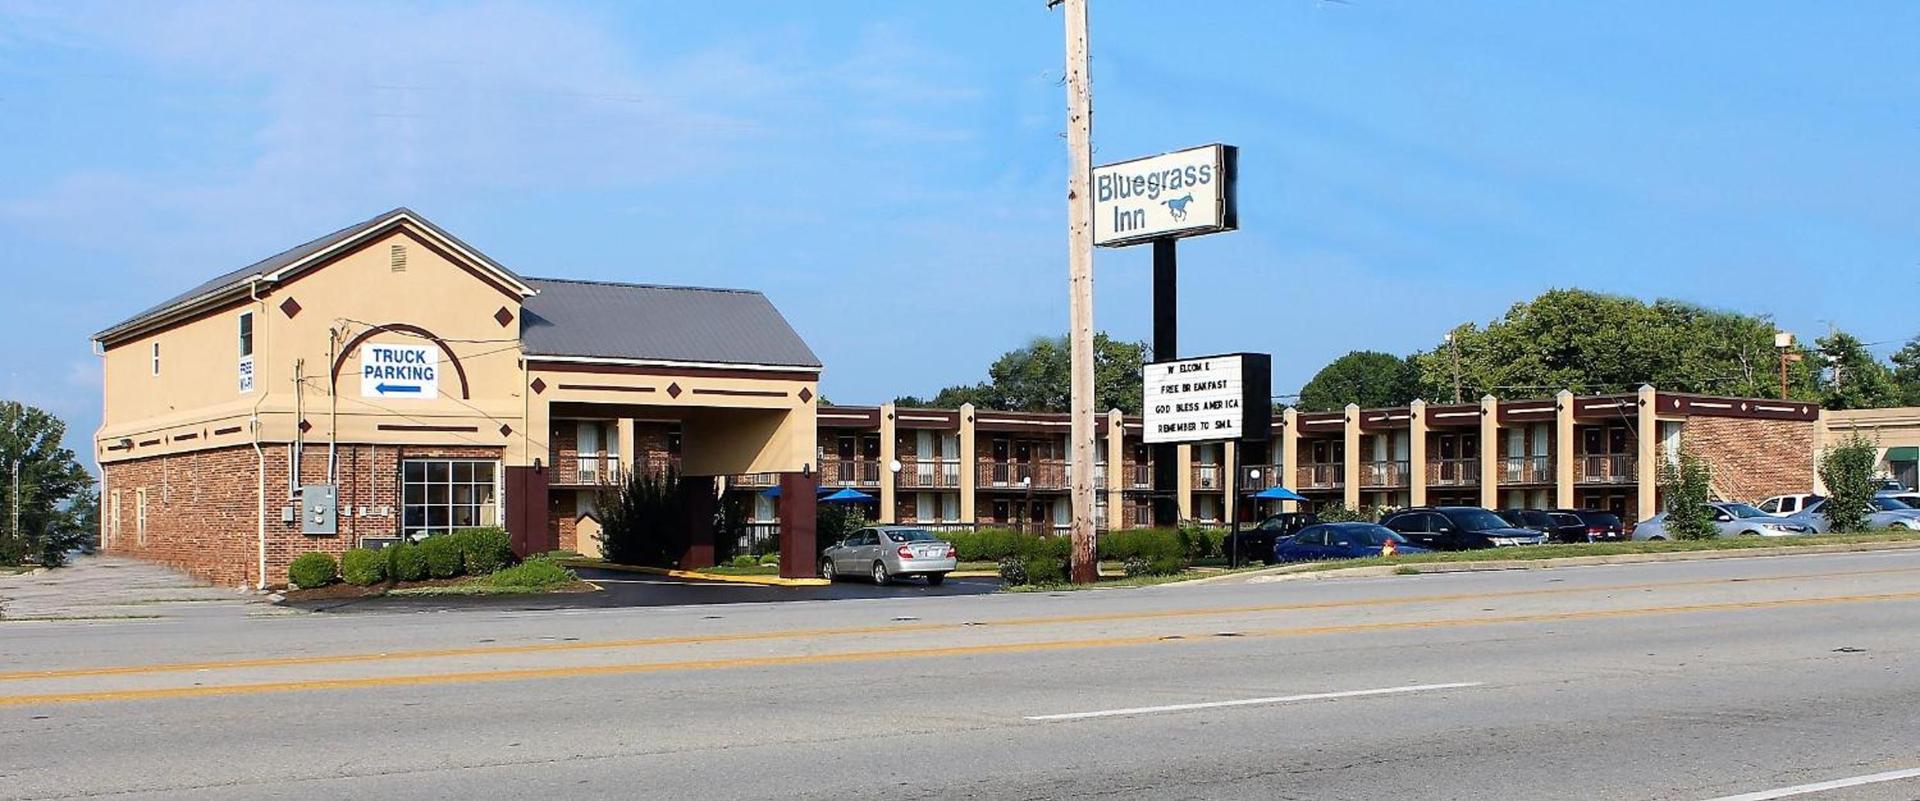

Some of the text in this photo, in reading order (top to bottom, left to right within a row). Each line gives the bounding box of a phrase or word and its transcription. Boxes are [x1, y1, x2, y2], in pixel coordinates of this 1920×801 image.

[1098, 164, 1211, 202] Bluegrass
[1113, 205, 1146, 233] Inn
[372, 348, 426, 364] TRUCK
[364, 364, 435, 381] PARKING
[1160, 384, 1179, 395] FREE
[1155, 399, 1239, 414] GOD BLESS AMERICA
[1157, 422, 1197, 433] REMEMBER
[1200, 421, 1210, 430] TO
